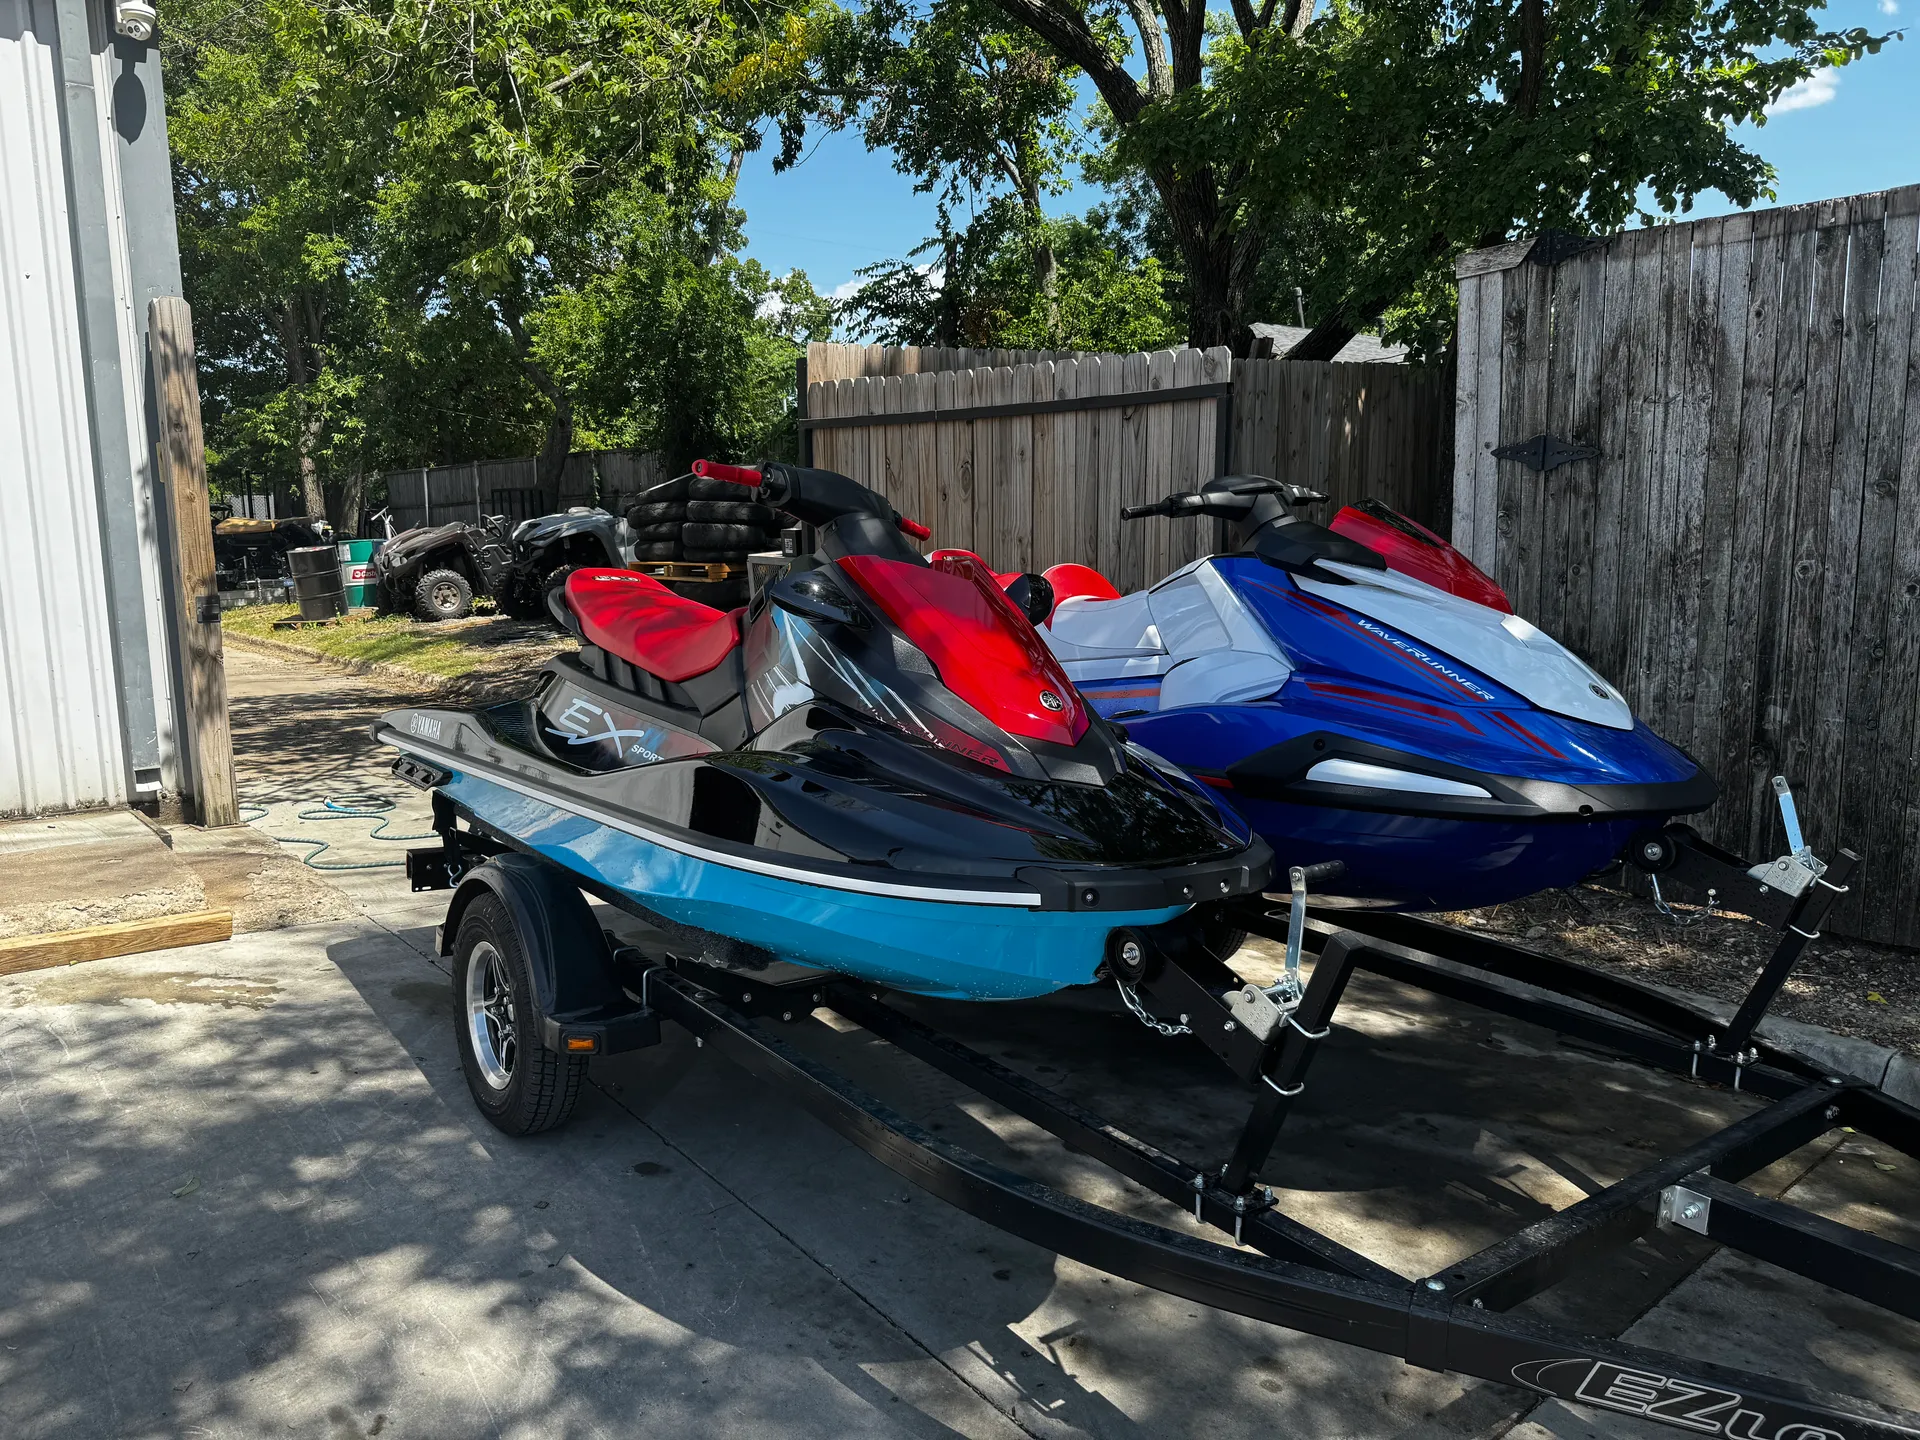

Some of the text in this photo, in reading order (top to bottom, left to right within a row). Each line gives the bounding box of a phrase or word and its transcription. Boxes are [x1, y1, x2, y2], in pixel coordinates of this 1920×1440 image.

[1357, 619, 1495, 700] WAVERUNNER
[416, 715, 442, 740] YAMAHA
[545, 698, 645, 759] EX
